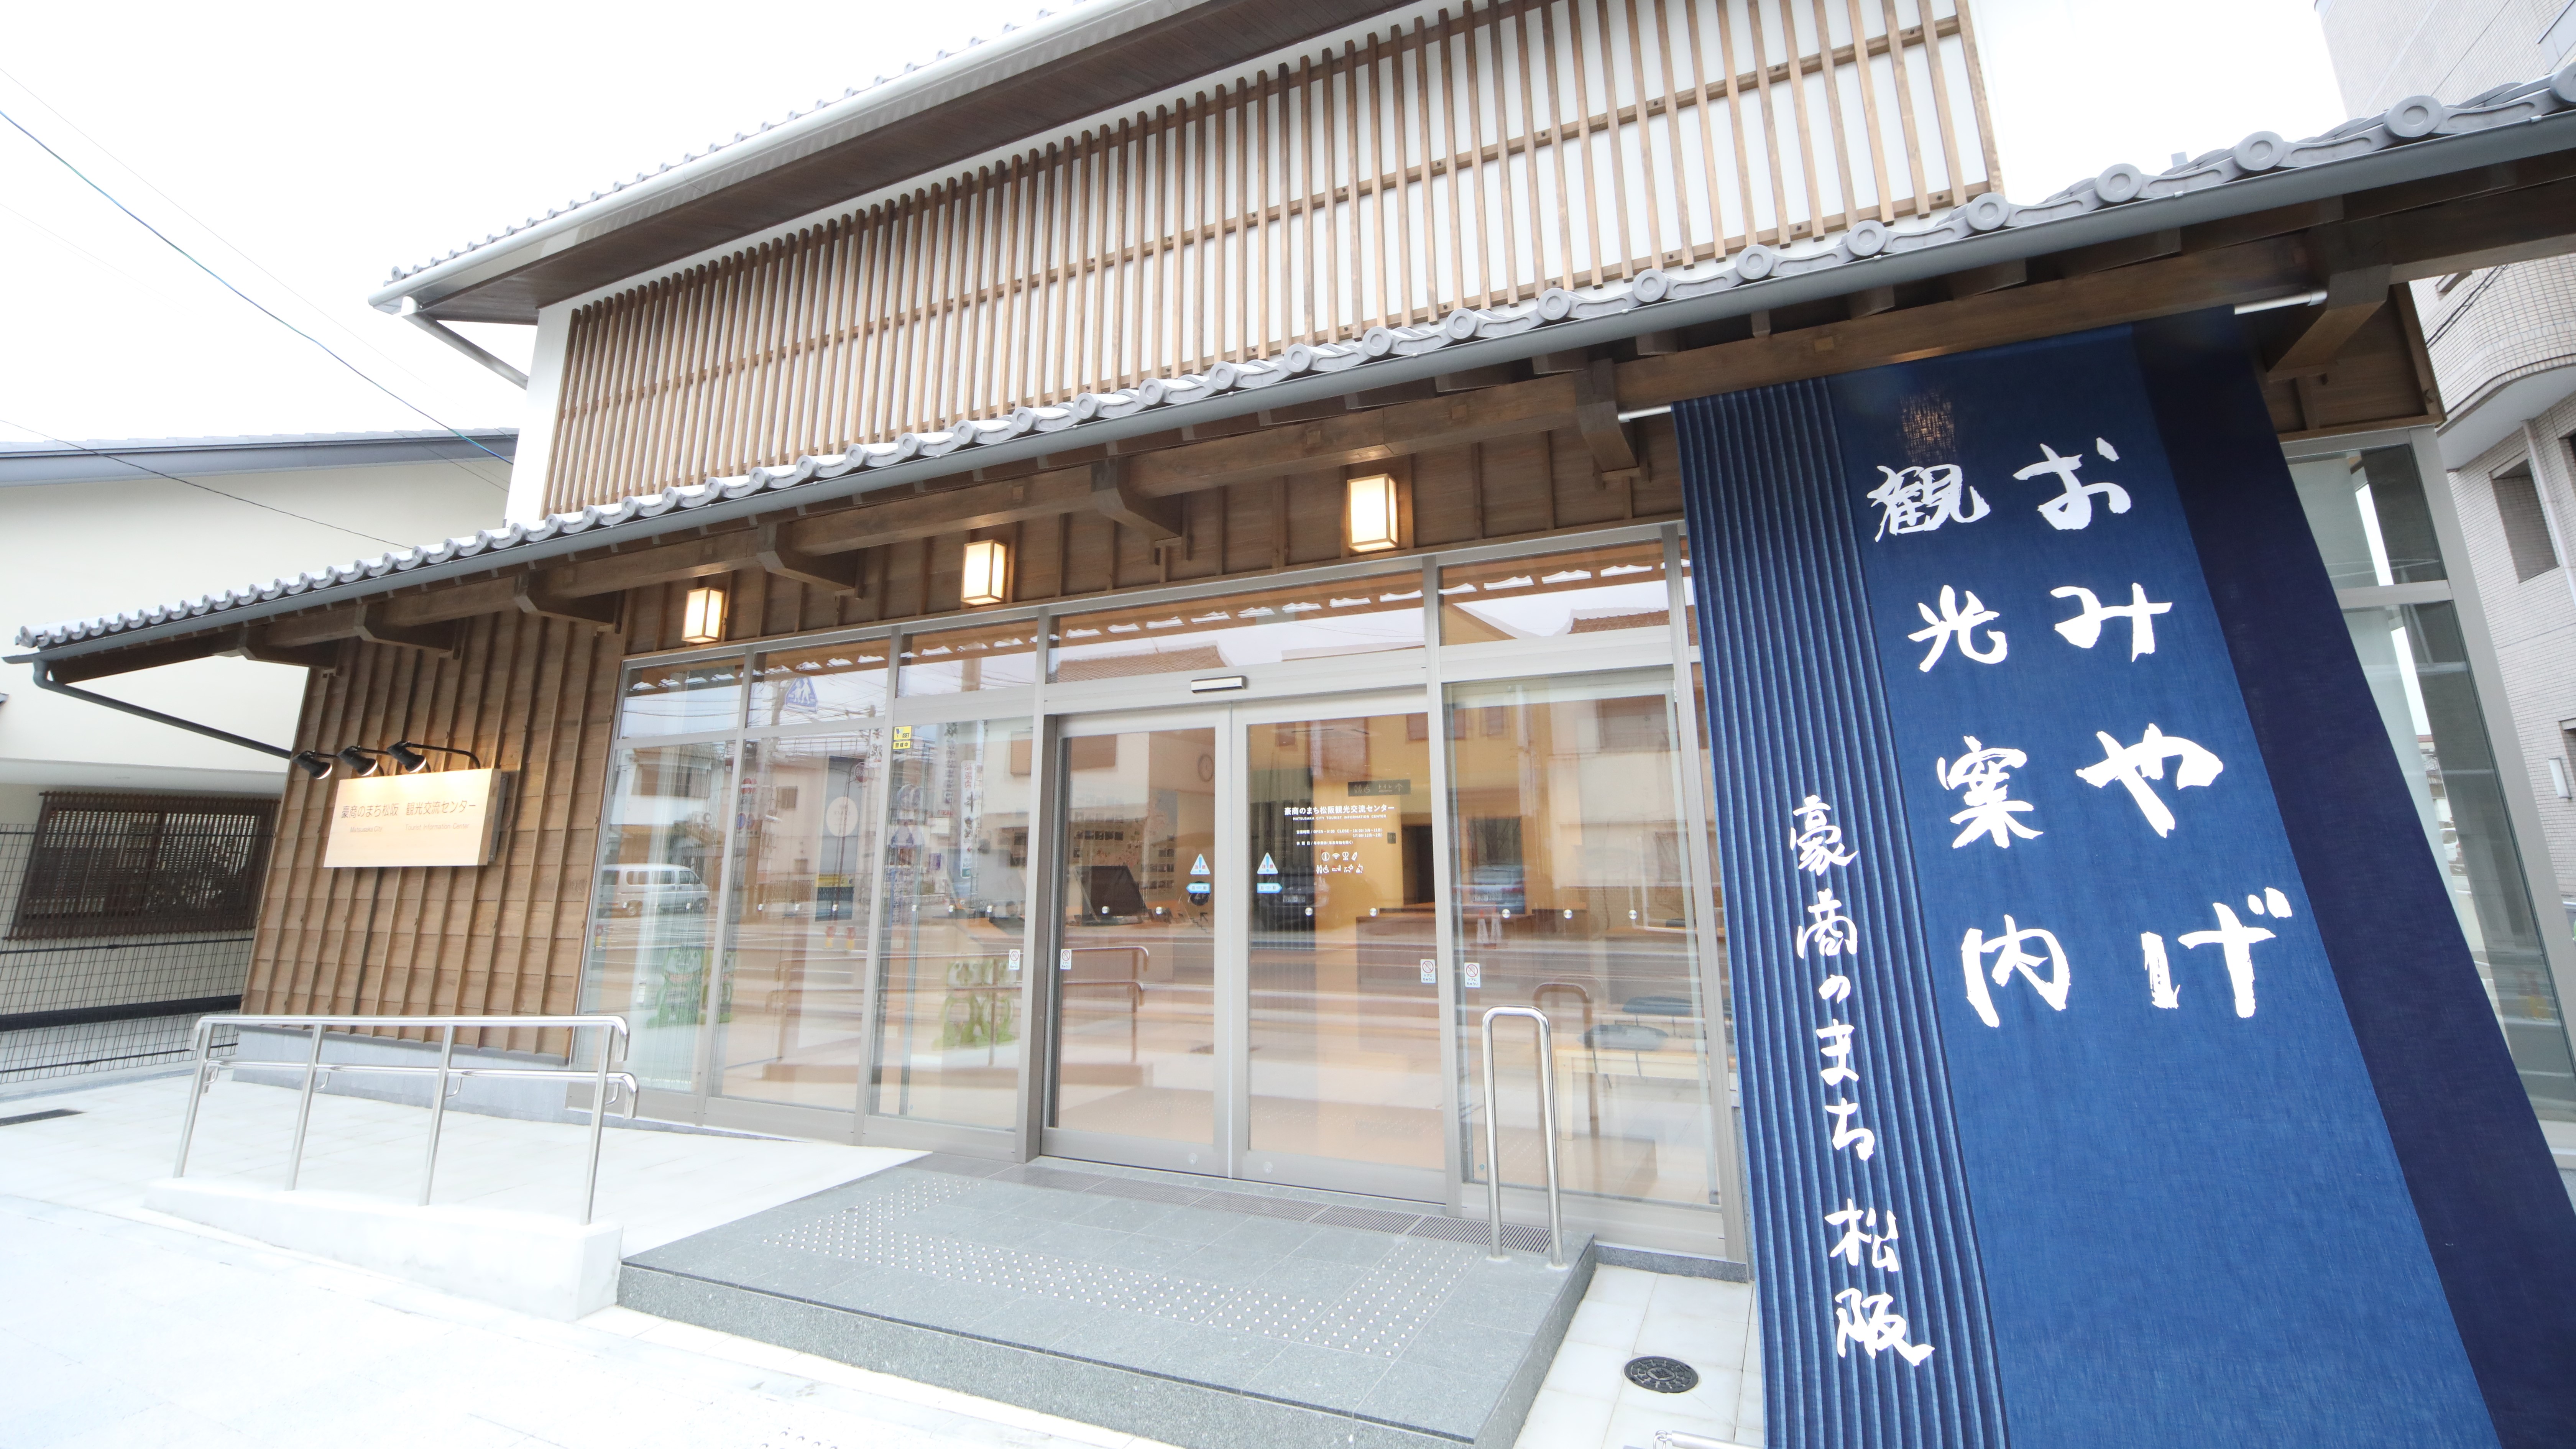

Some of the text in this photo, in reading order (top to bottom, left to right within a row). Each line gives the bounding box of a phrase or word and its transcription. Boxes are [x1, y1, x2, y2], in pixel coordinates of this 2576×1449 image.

[341, 800, 476, 818] 豪商のまち松阪 観光交流センター
[1284, 804, 1395, 815] 豪商のまち松阪観光交流センター
[1867, 464, 2071, 1028] 観光案内
[2014, 437, 2292, 1018] おみやげ
